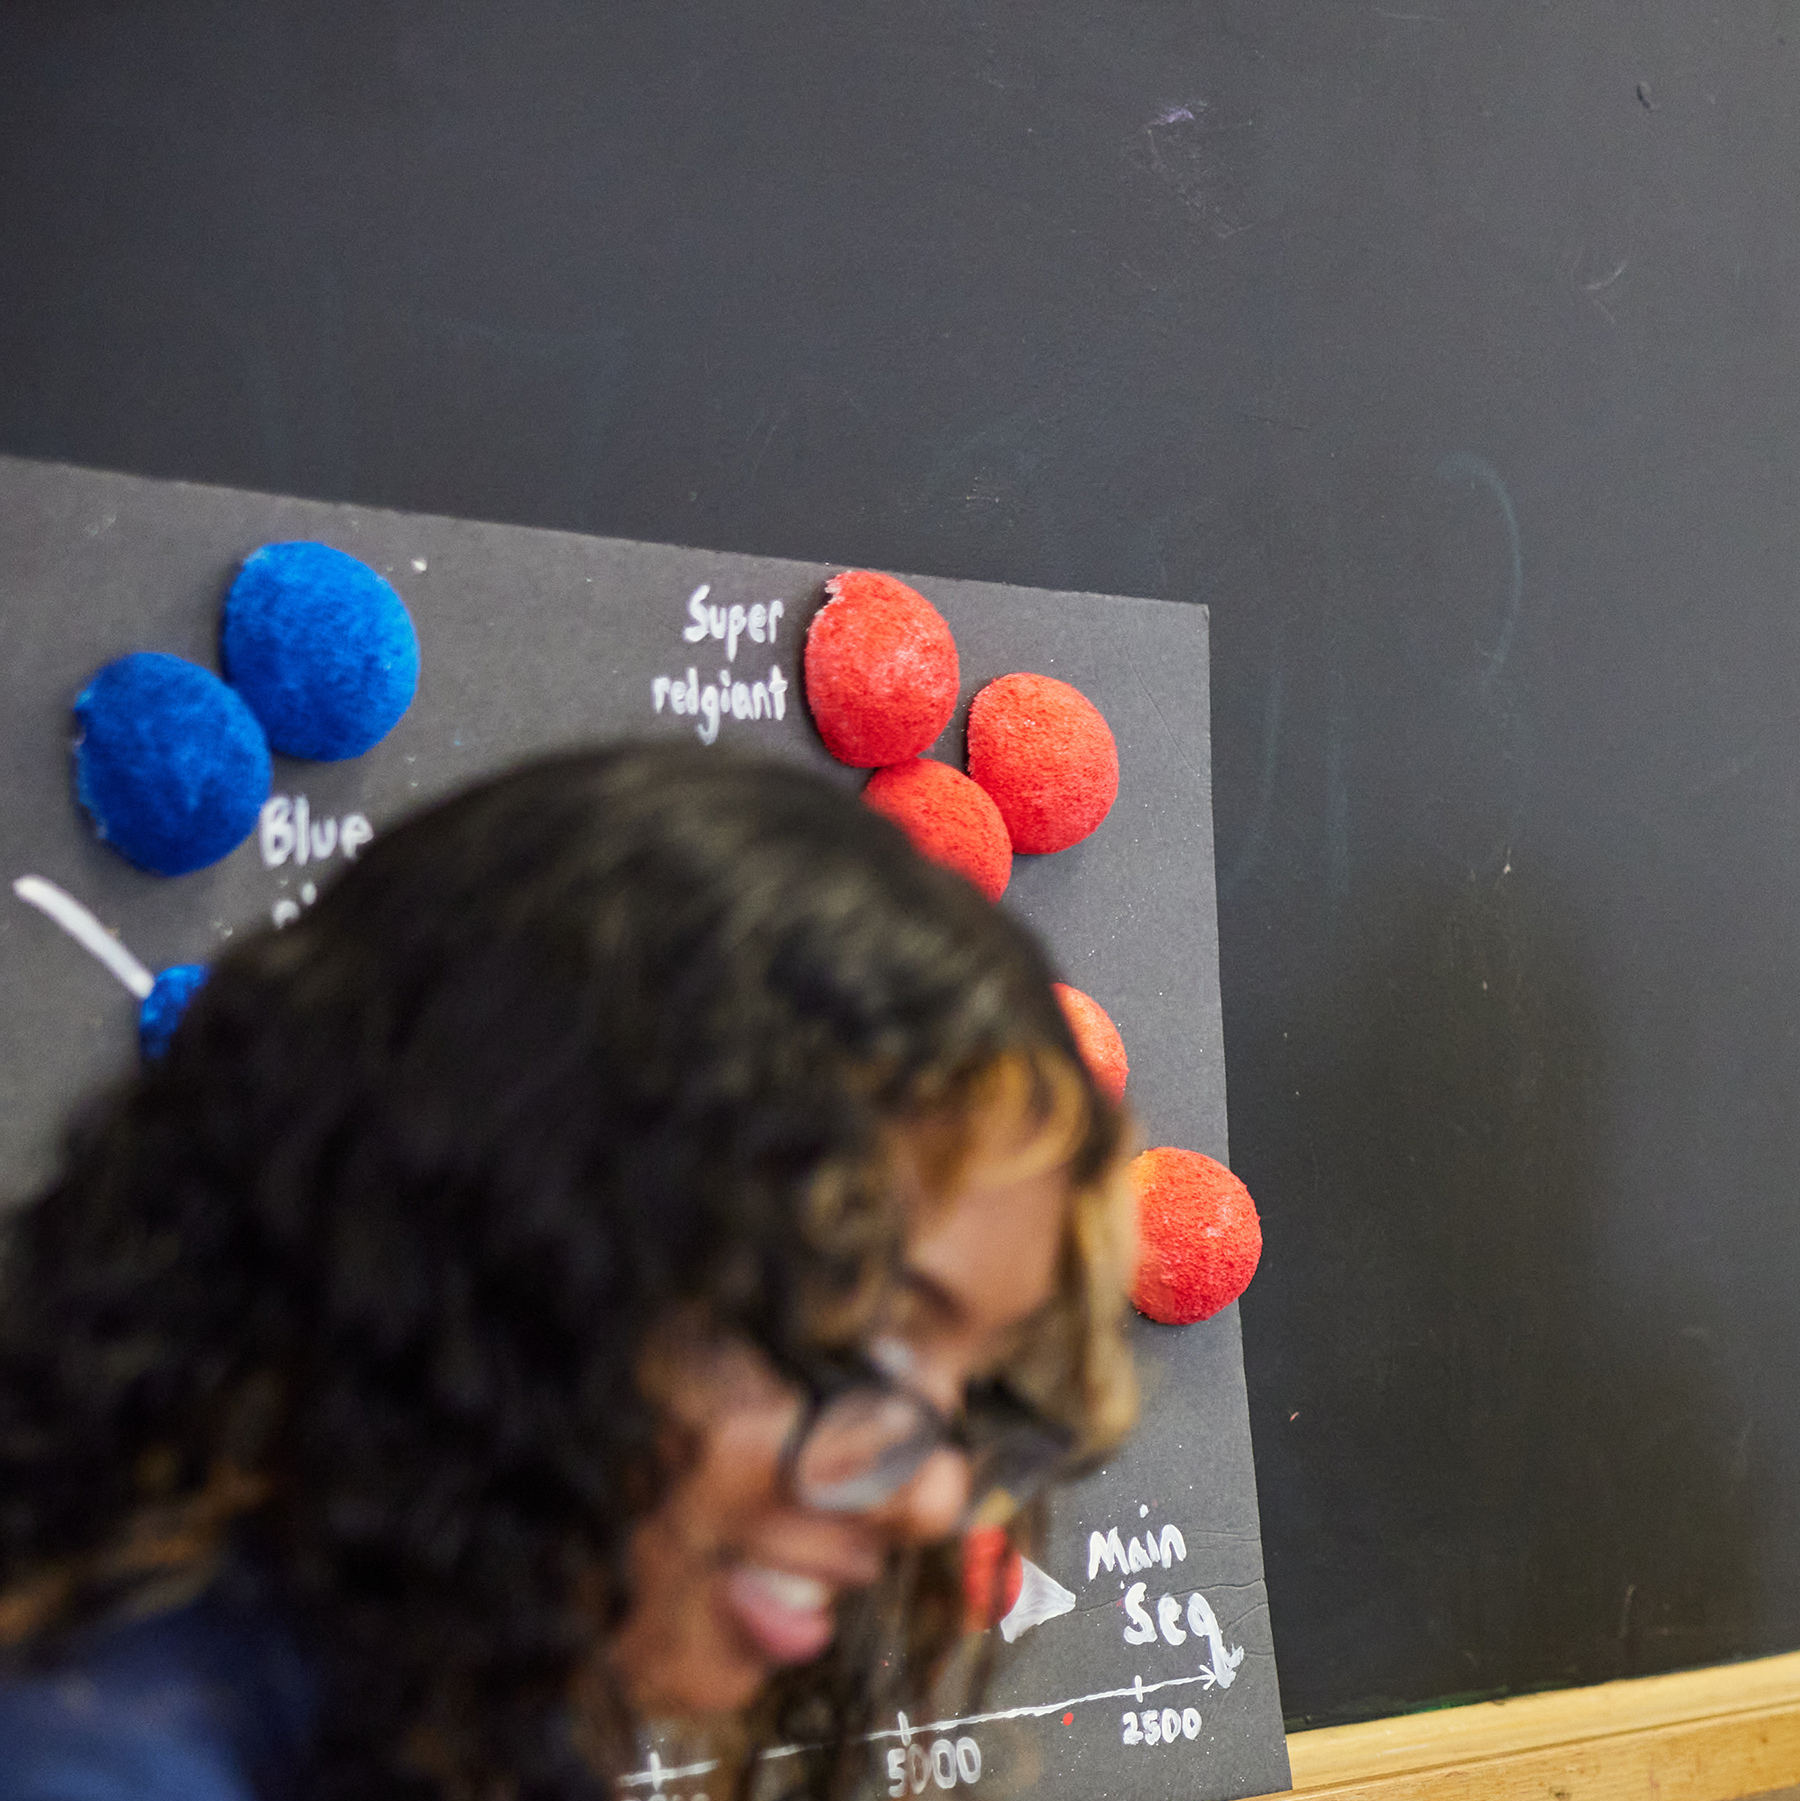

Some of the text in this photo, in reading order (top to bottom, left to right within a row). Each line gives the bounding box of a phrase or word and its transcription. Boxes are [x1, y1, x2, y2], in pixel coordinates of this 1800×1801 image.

[683, 583, 785, 663] Super
[259, 793, 375, 869] Blue
[1088, 1503, 1188, 1580] Main
[887, 1736, 982, 1798] 5000
[1122, 1708, 1202, 1746] 2500
